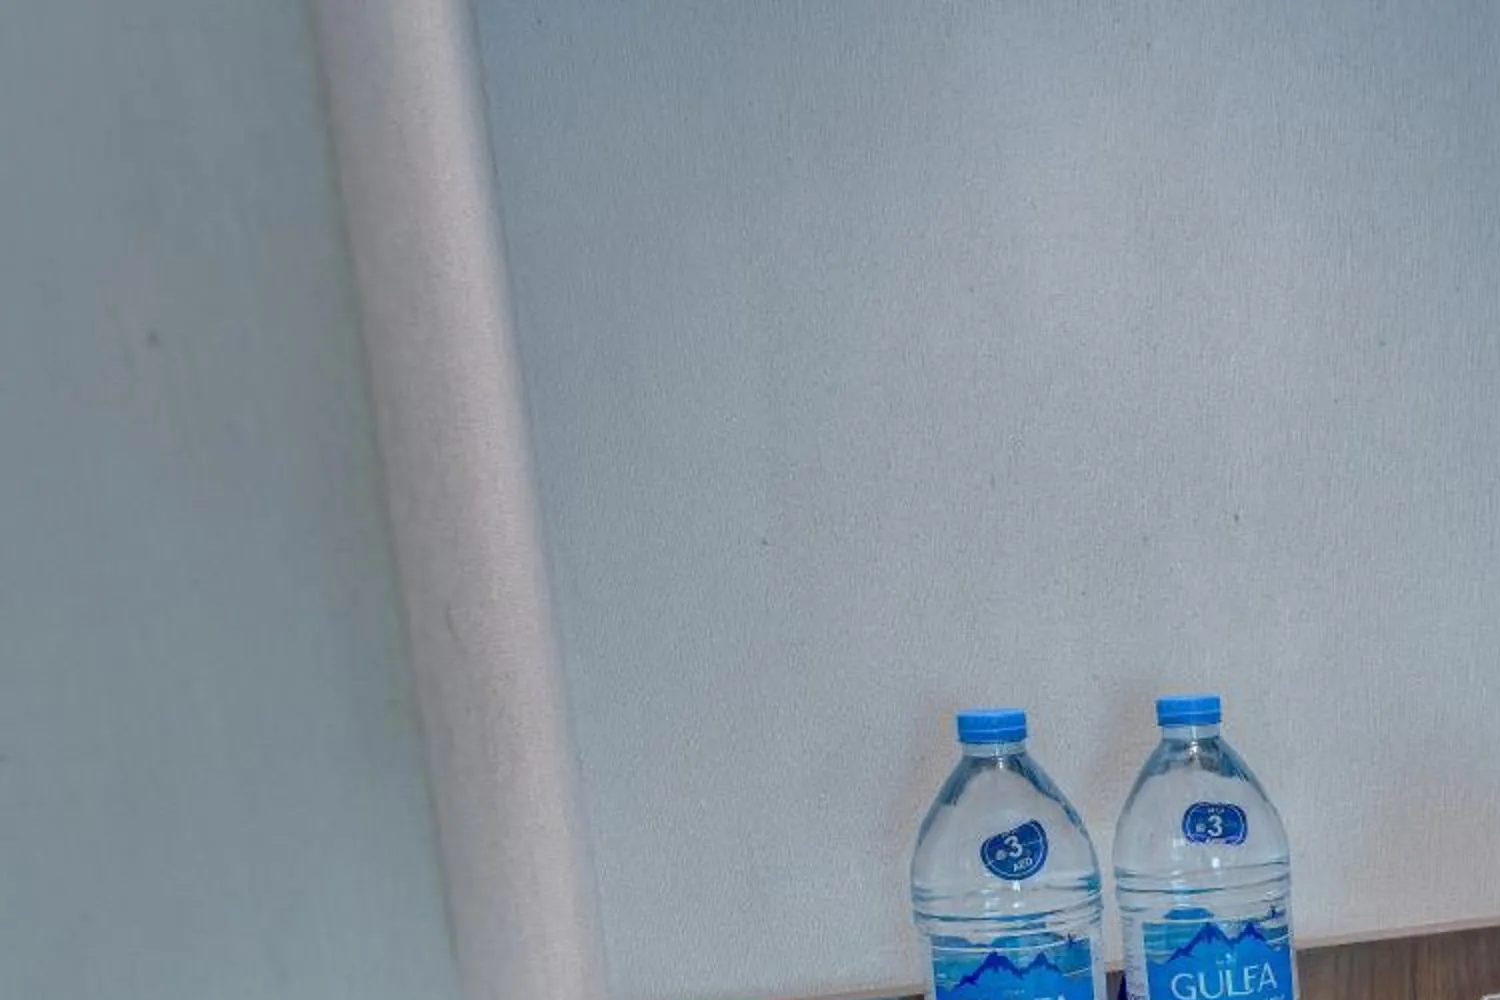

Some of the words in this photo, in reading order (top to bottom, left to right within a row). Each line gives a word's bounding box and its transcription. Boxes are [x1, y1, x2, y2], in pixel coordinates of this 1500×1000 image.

[1207, 815, 1223, 837] 3
[1004, 835, 1022, 857] 3
[1171, 961, 1278, 1000] GULFA
